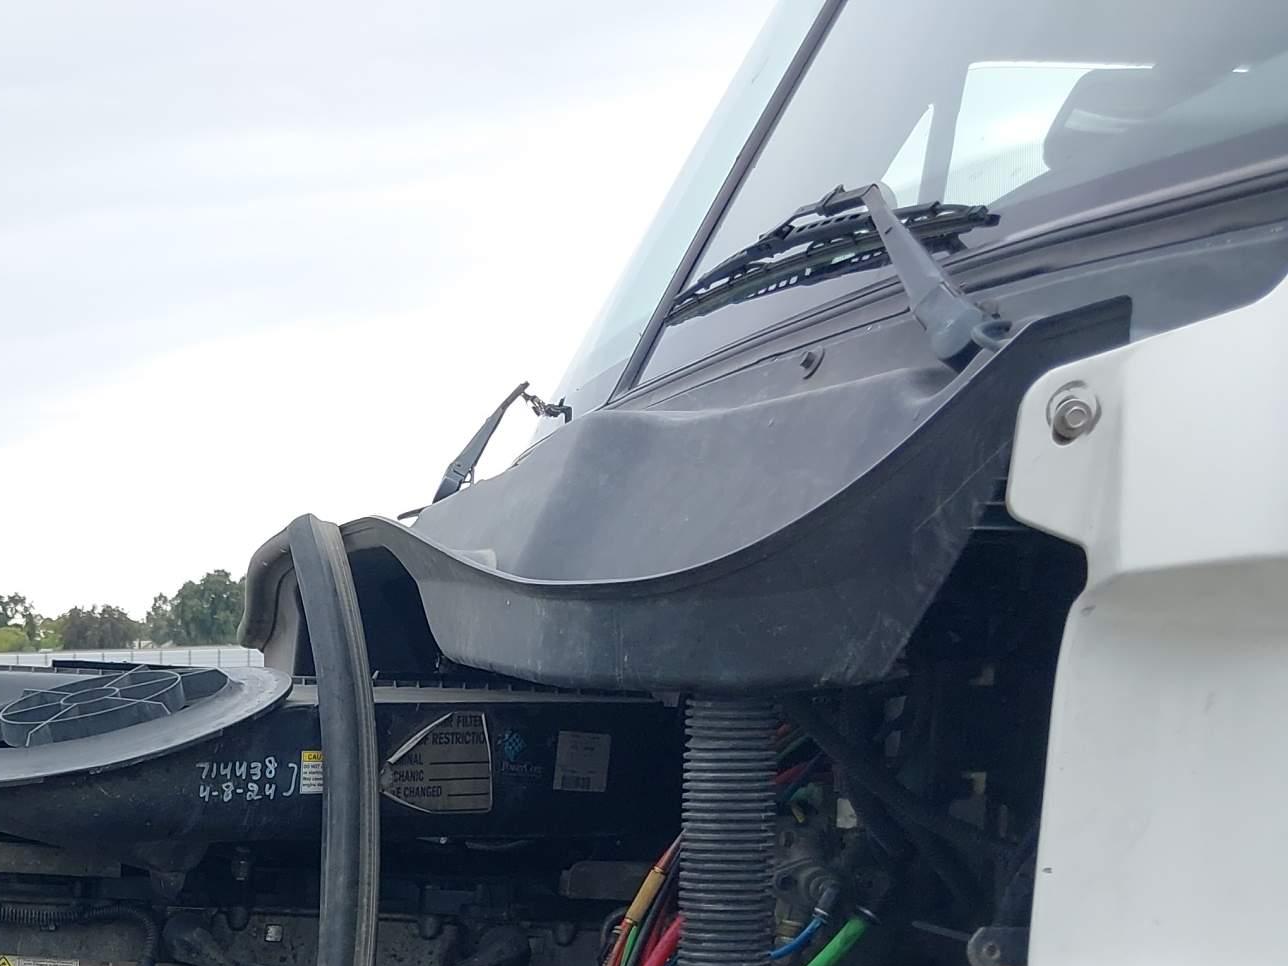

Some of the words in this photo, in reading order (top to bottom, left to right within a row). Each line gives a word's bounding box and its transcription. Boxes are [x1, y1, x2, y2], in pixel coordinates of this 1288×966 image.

[196, 756, 278, 781] 714438
[199, 781, 276, 802] 4-8-24
[403, 785, 442, 798] CHANGED
